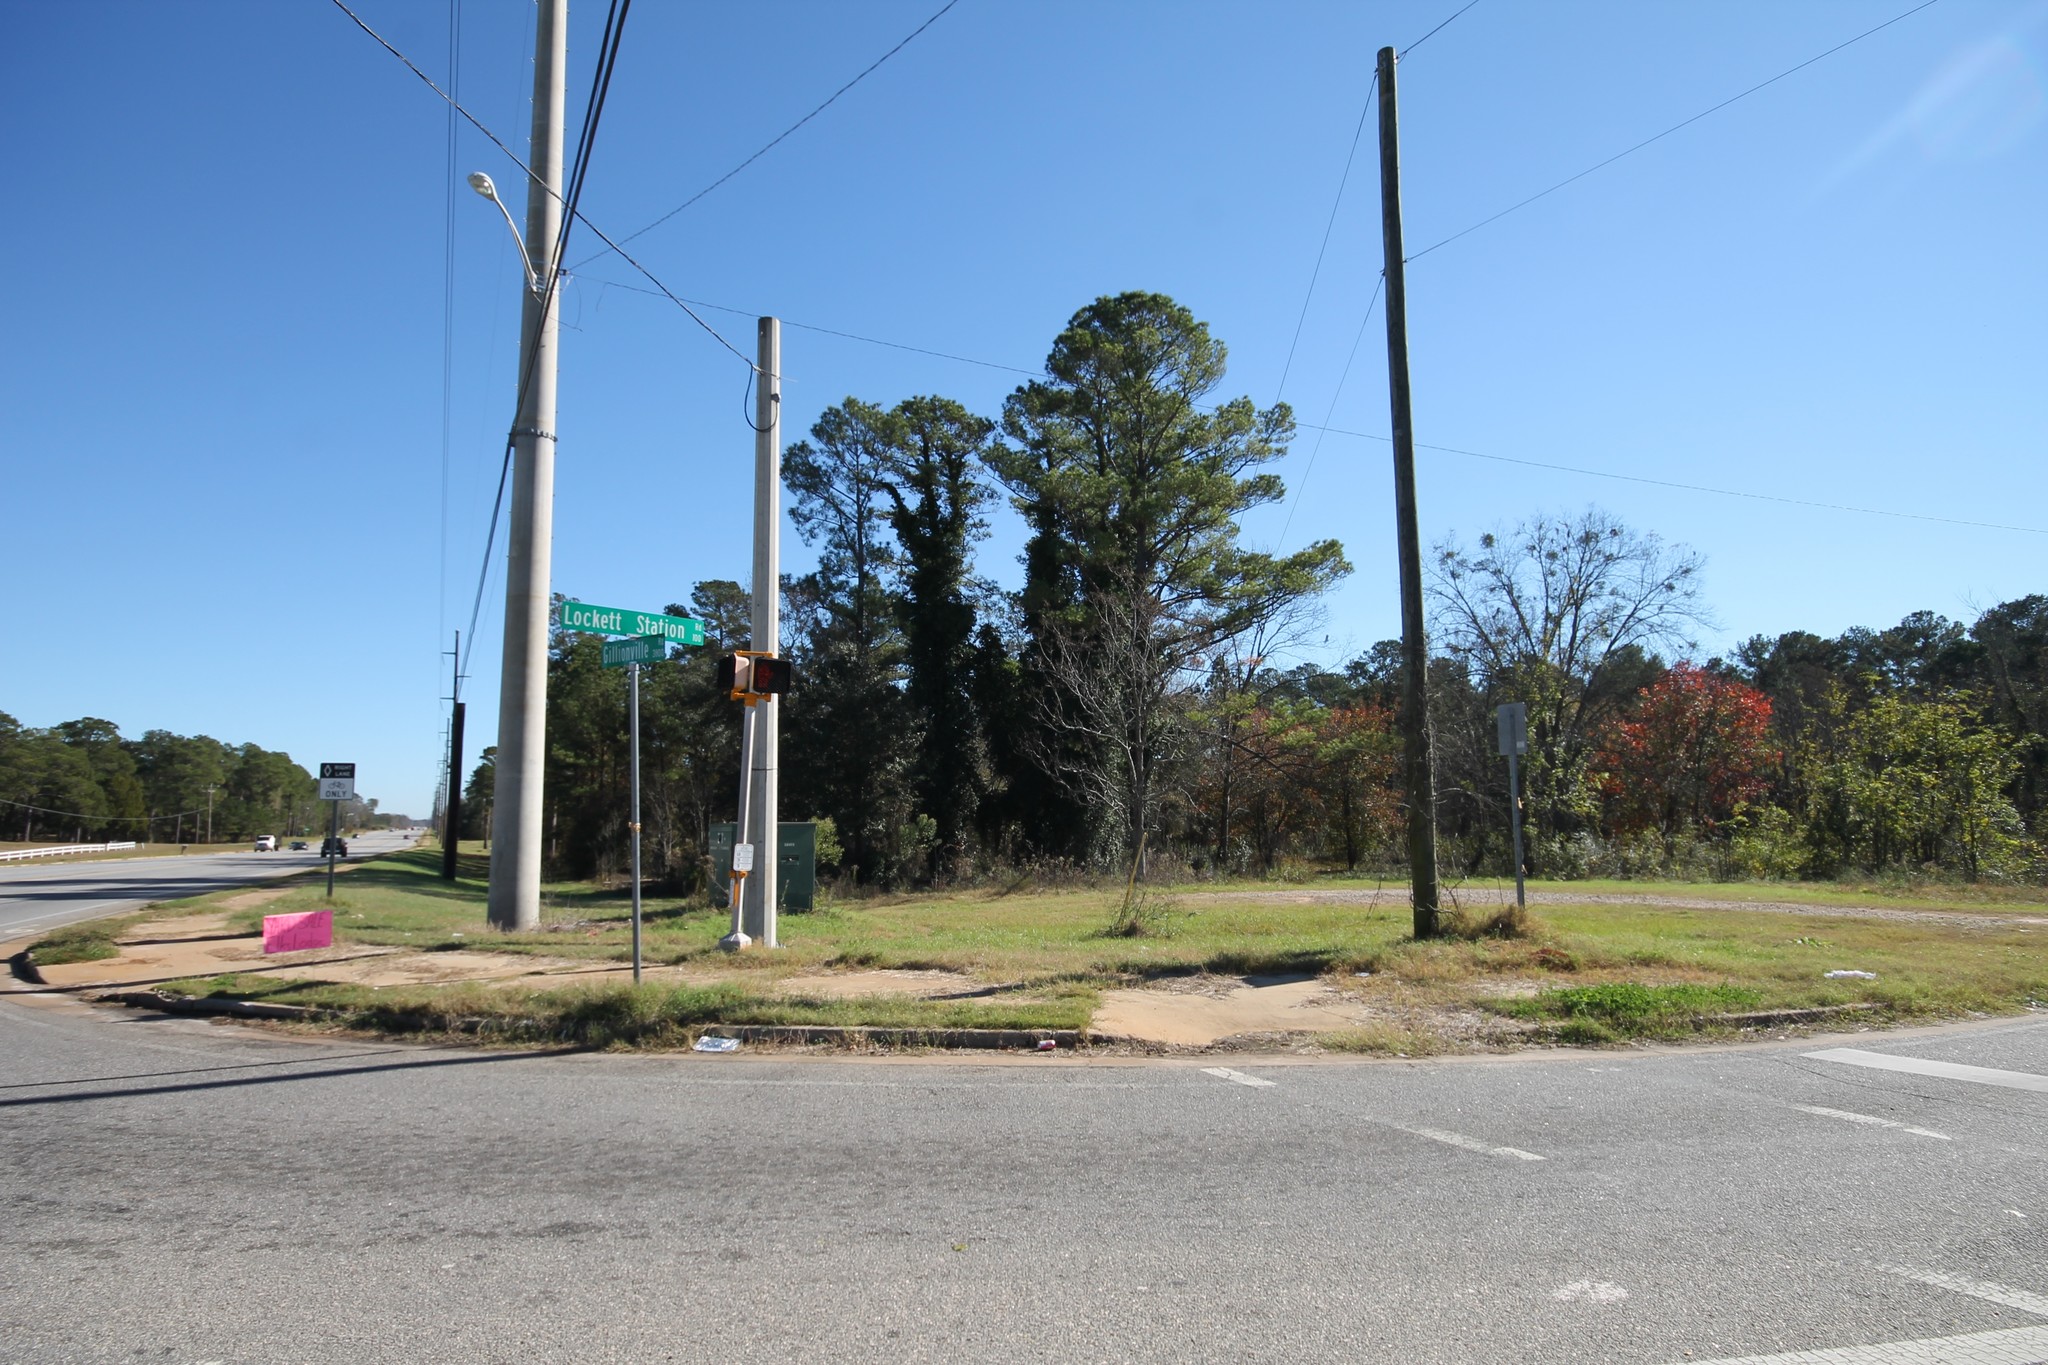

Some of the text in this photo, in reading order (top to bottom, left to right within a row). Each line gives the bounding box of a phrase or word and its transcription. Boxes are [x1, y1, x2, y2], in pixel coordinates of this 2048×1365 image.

[564, 604, 685, 639] Lockett Station
[692, 634, 702, 642] 100
[603, 641, 649, 664] Gillionville
[325, 790, 347, 798] ONLY
